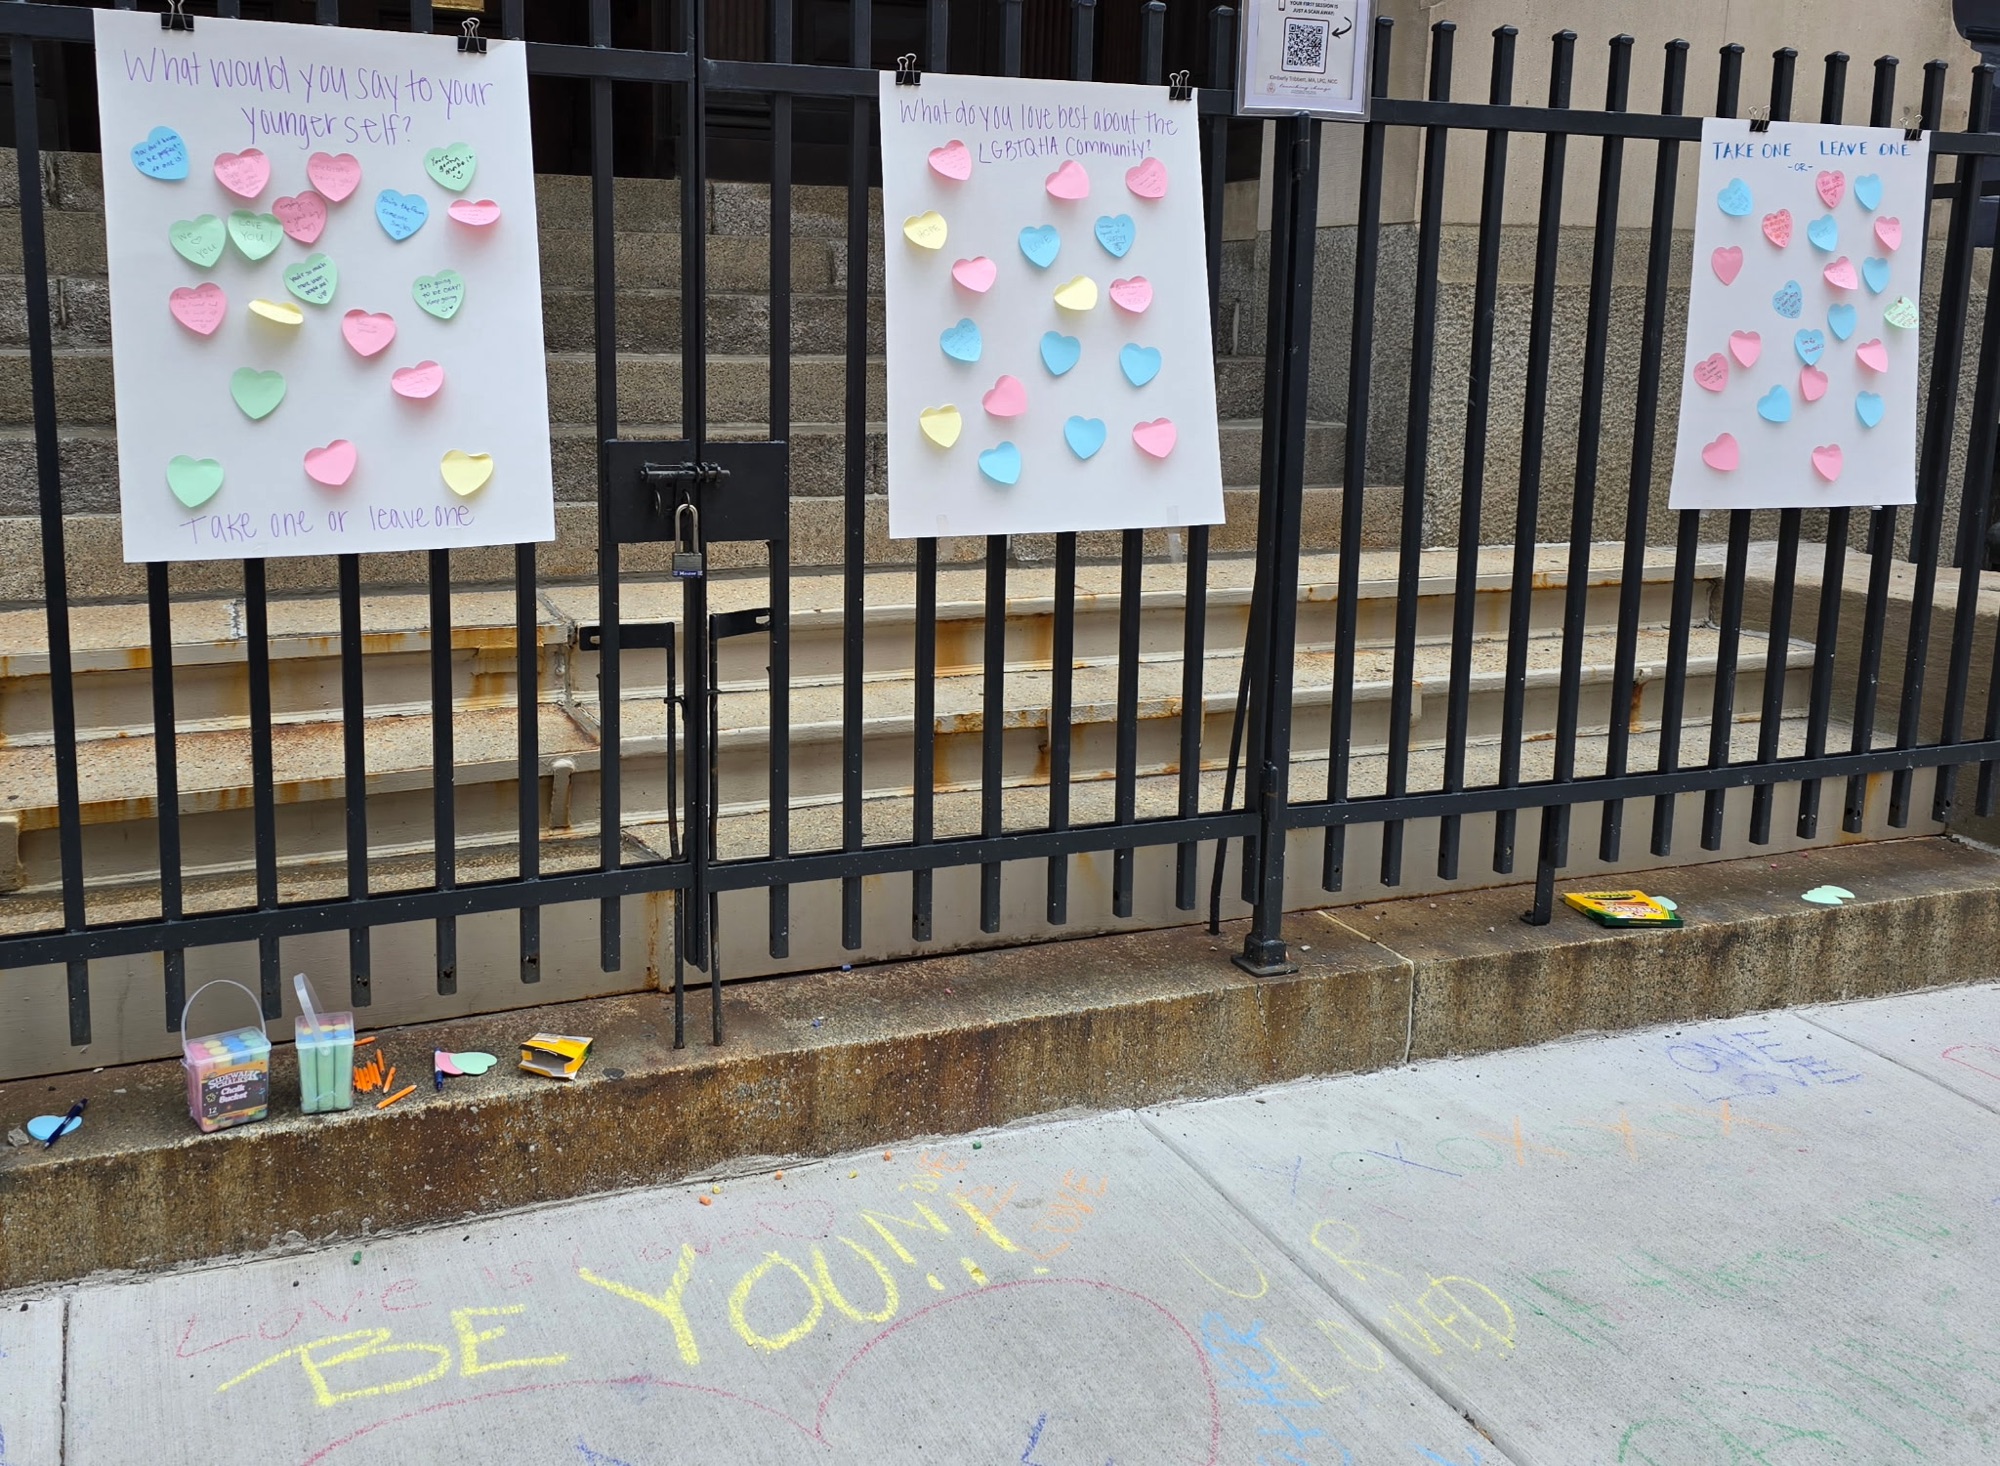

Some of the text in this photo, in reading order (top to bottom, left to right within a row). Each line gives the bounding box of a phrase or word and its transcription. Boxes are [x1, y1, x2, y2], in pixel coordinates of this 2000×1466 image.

[123, 48, 494, 119] What would you say to your
[899, 99, 1179, 136] What do you love best about the
[240, 107, 412, 149] younger self?
[1713, 141, 1792, 160] TAKE ONE
[1820, 140, 1911, 157] LEAVE ONE
[916, 223, 941, 239] HOPE
[1029, 233, 1052, 254] LOVE
[179, 504, 475, 544] Take one or leave one
[219, 1091, 248, 1104] Bucket
[221, 1084, 245, 1096] Chalk
[208, 1106, 217, 1114] 12
[215, 1302, 569, 1408] BE
